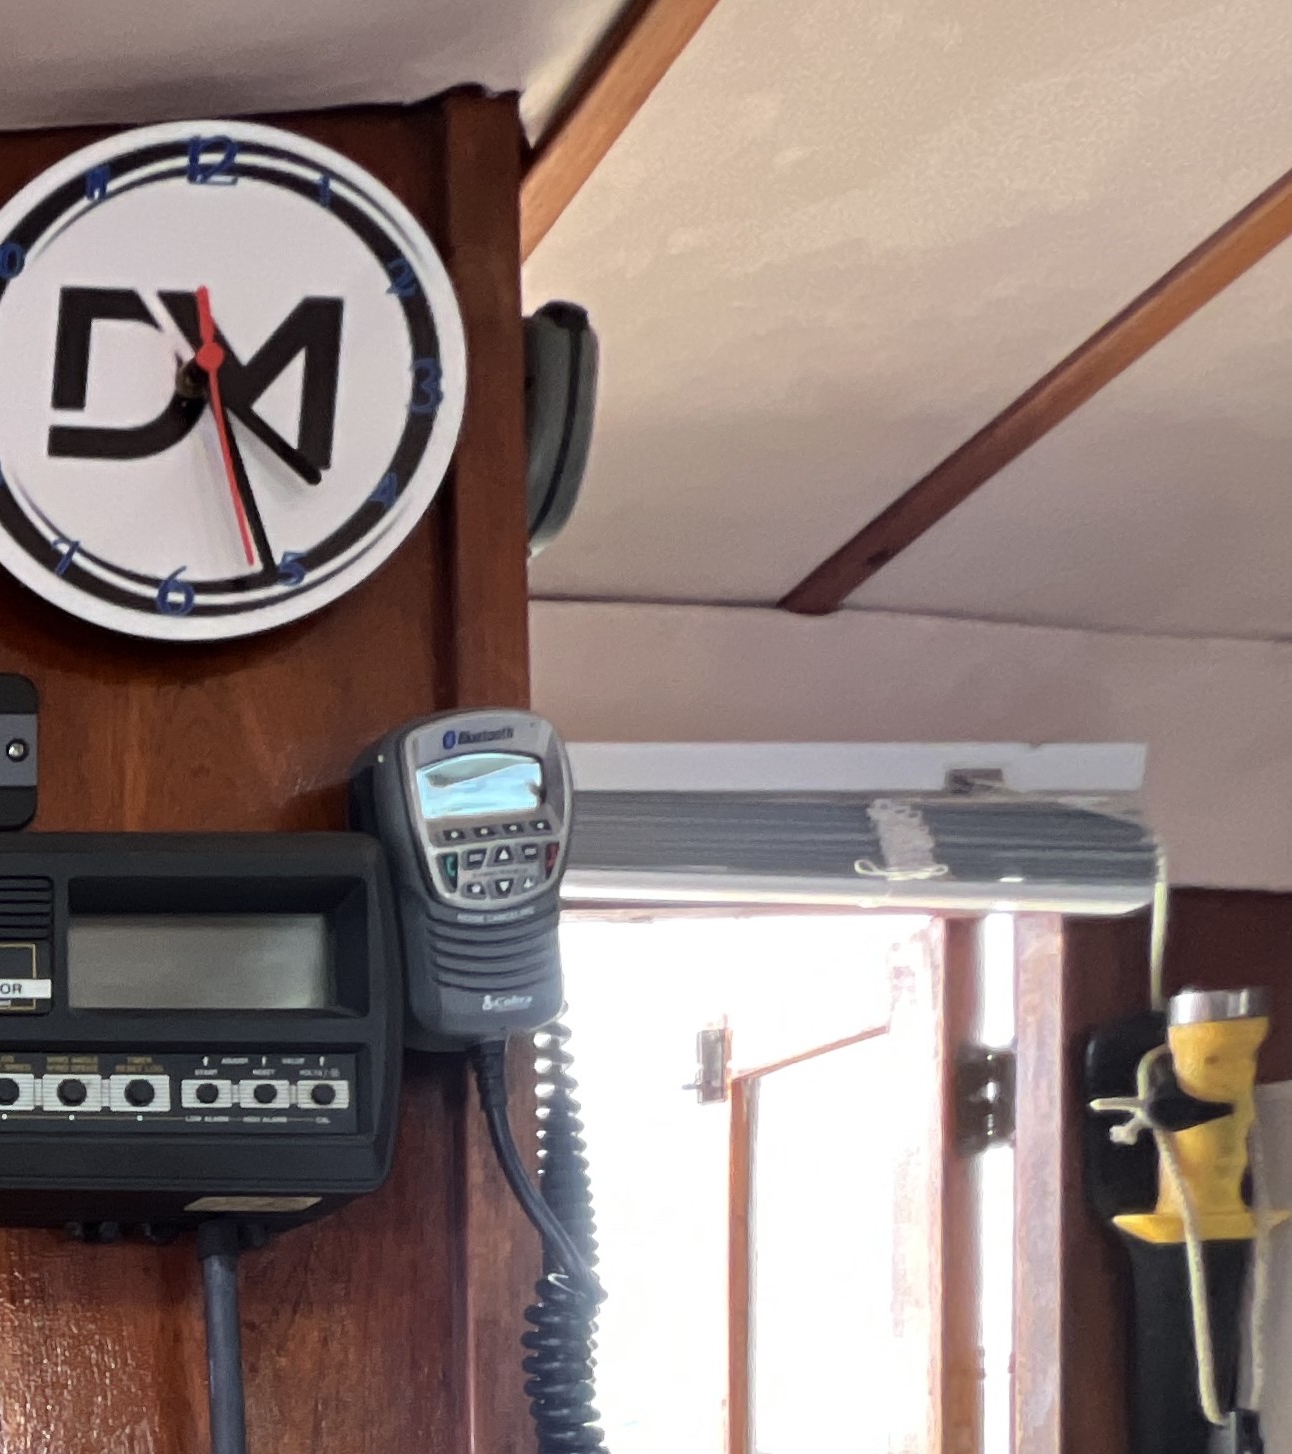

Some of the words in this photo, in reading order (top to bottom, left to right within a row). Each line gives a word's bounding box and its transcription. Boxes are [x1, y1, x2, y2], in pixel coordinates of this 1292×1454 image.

[187, 134, 238, 185] 12
[319, 174, 331, 208] 1
[386, 257, 416, 296] 2
[409, 357, 443, 414] 3
[366, 472, 397, 508] 4
[52, 540, 80, 577] 7
[278, 551, 307, 587] 5
[156, 565, 195, 617] 6
[457, 727, 513, 746] Bluetooth
